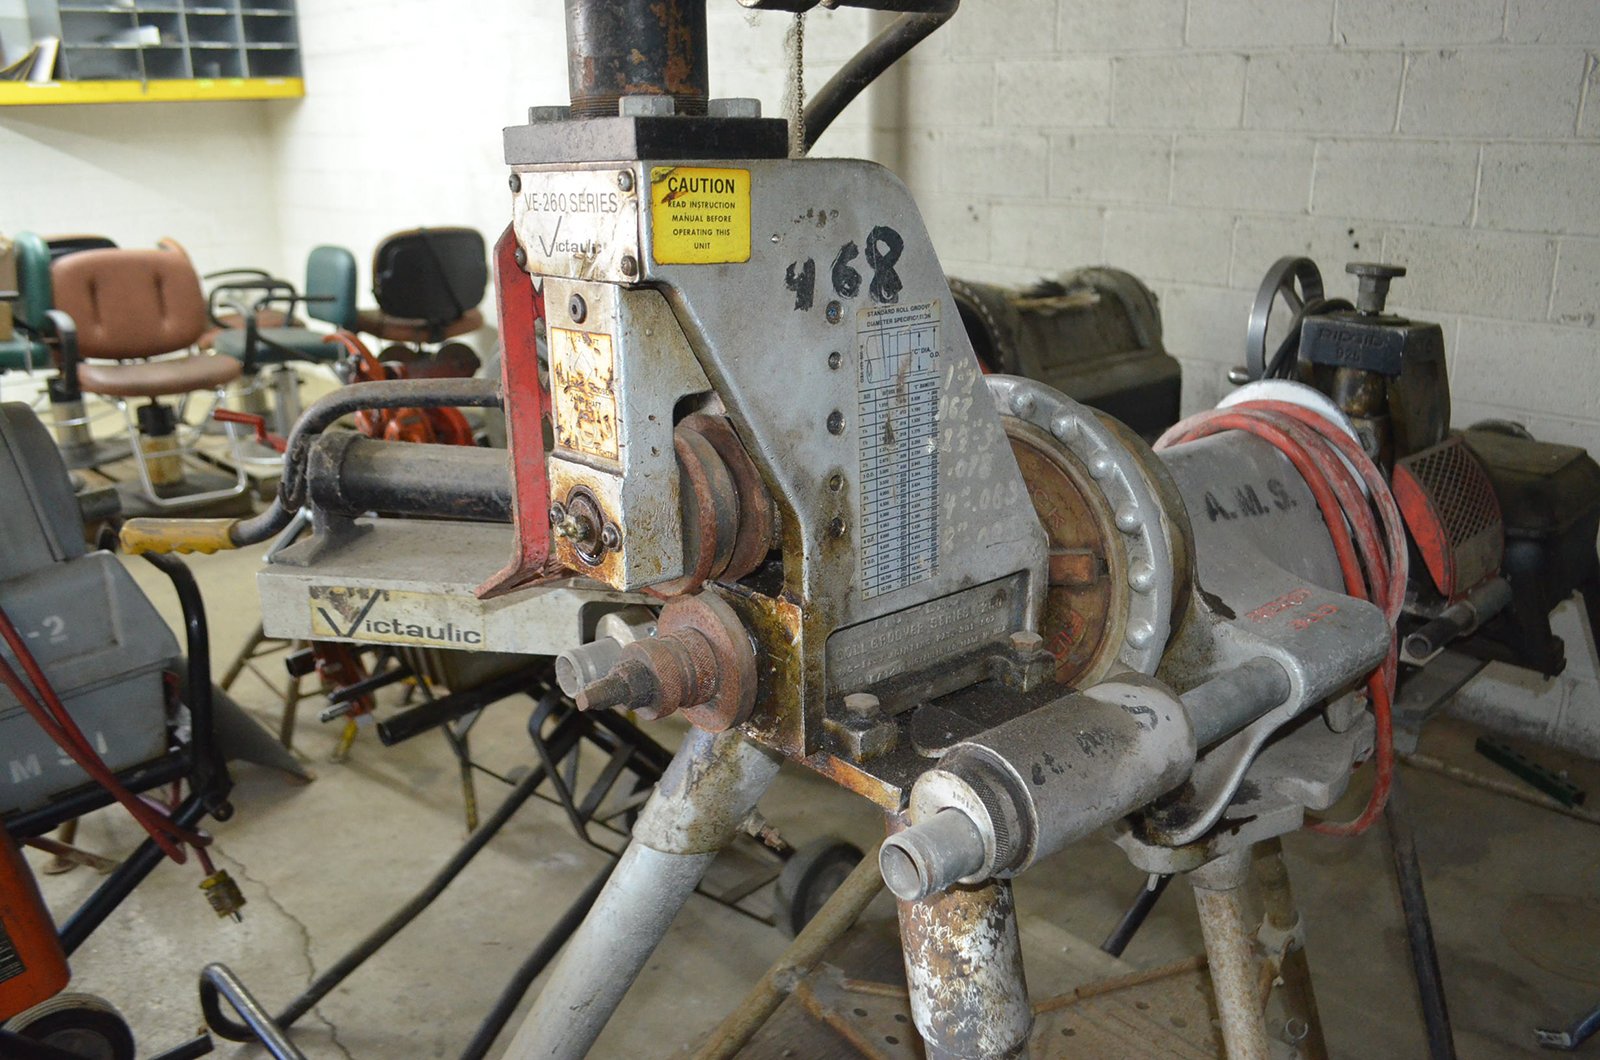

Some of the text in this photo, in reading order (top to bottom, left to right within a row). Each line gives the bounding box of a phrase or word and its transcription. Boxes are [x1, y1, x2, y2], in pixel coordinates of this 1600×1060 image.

[667, 177, 735, 194] CAUTION
[524, 191, 618, 214] VE-260 SERIES
[667, 201, 736, 209] READ INSTRUCTION
[671, 214, 732, 223] MANUAL BEFORE
[538, 215, 603, 258] Victaulic
[672, 228, 731, 237] OPERATING THIS
[693, 241, 711, 250] UNIT
[866, 307, 895, 318] STANDARD
[896, 306, 909, 315] ROLL
[316, 588, 482, 645] Victaulic
